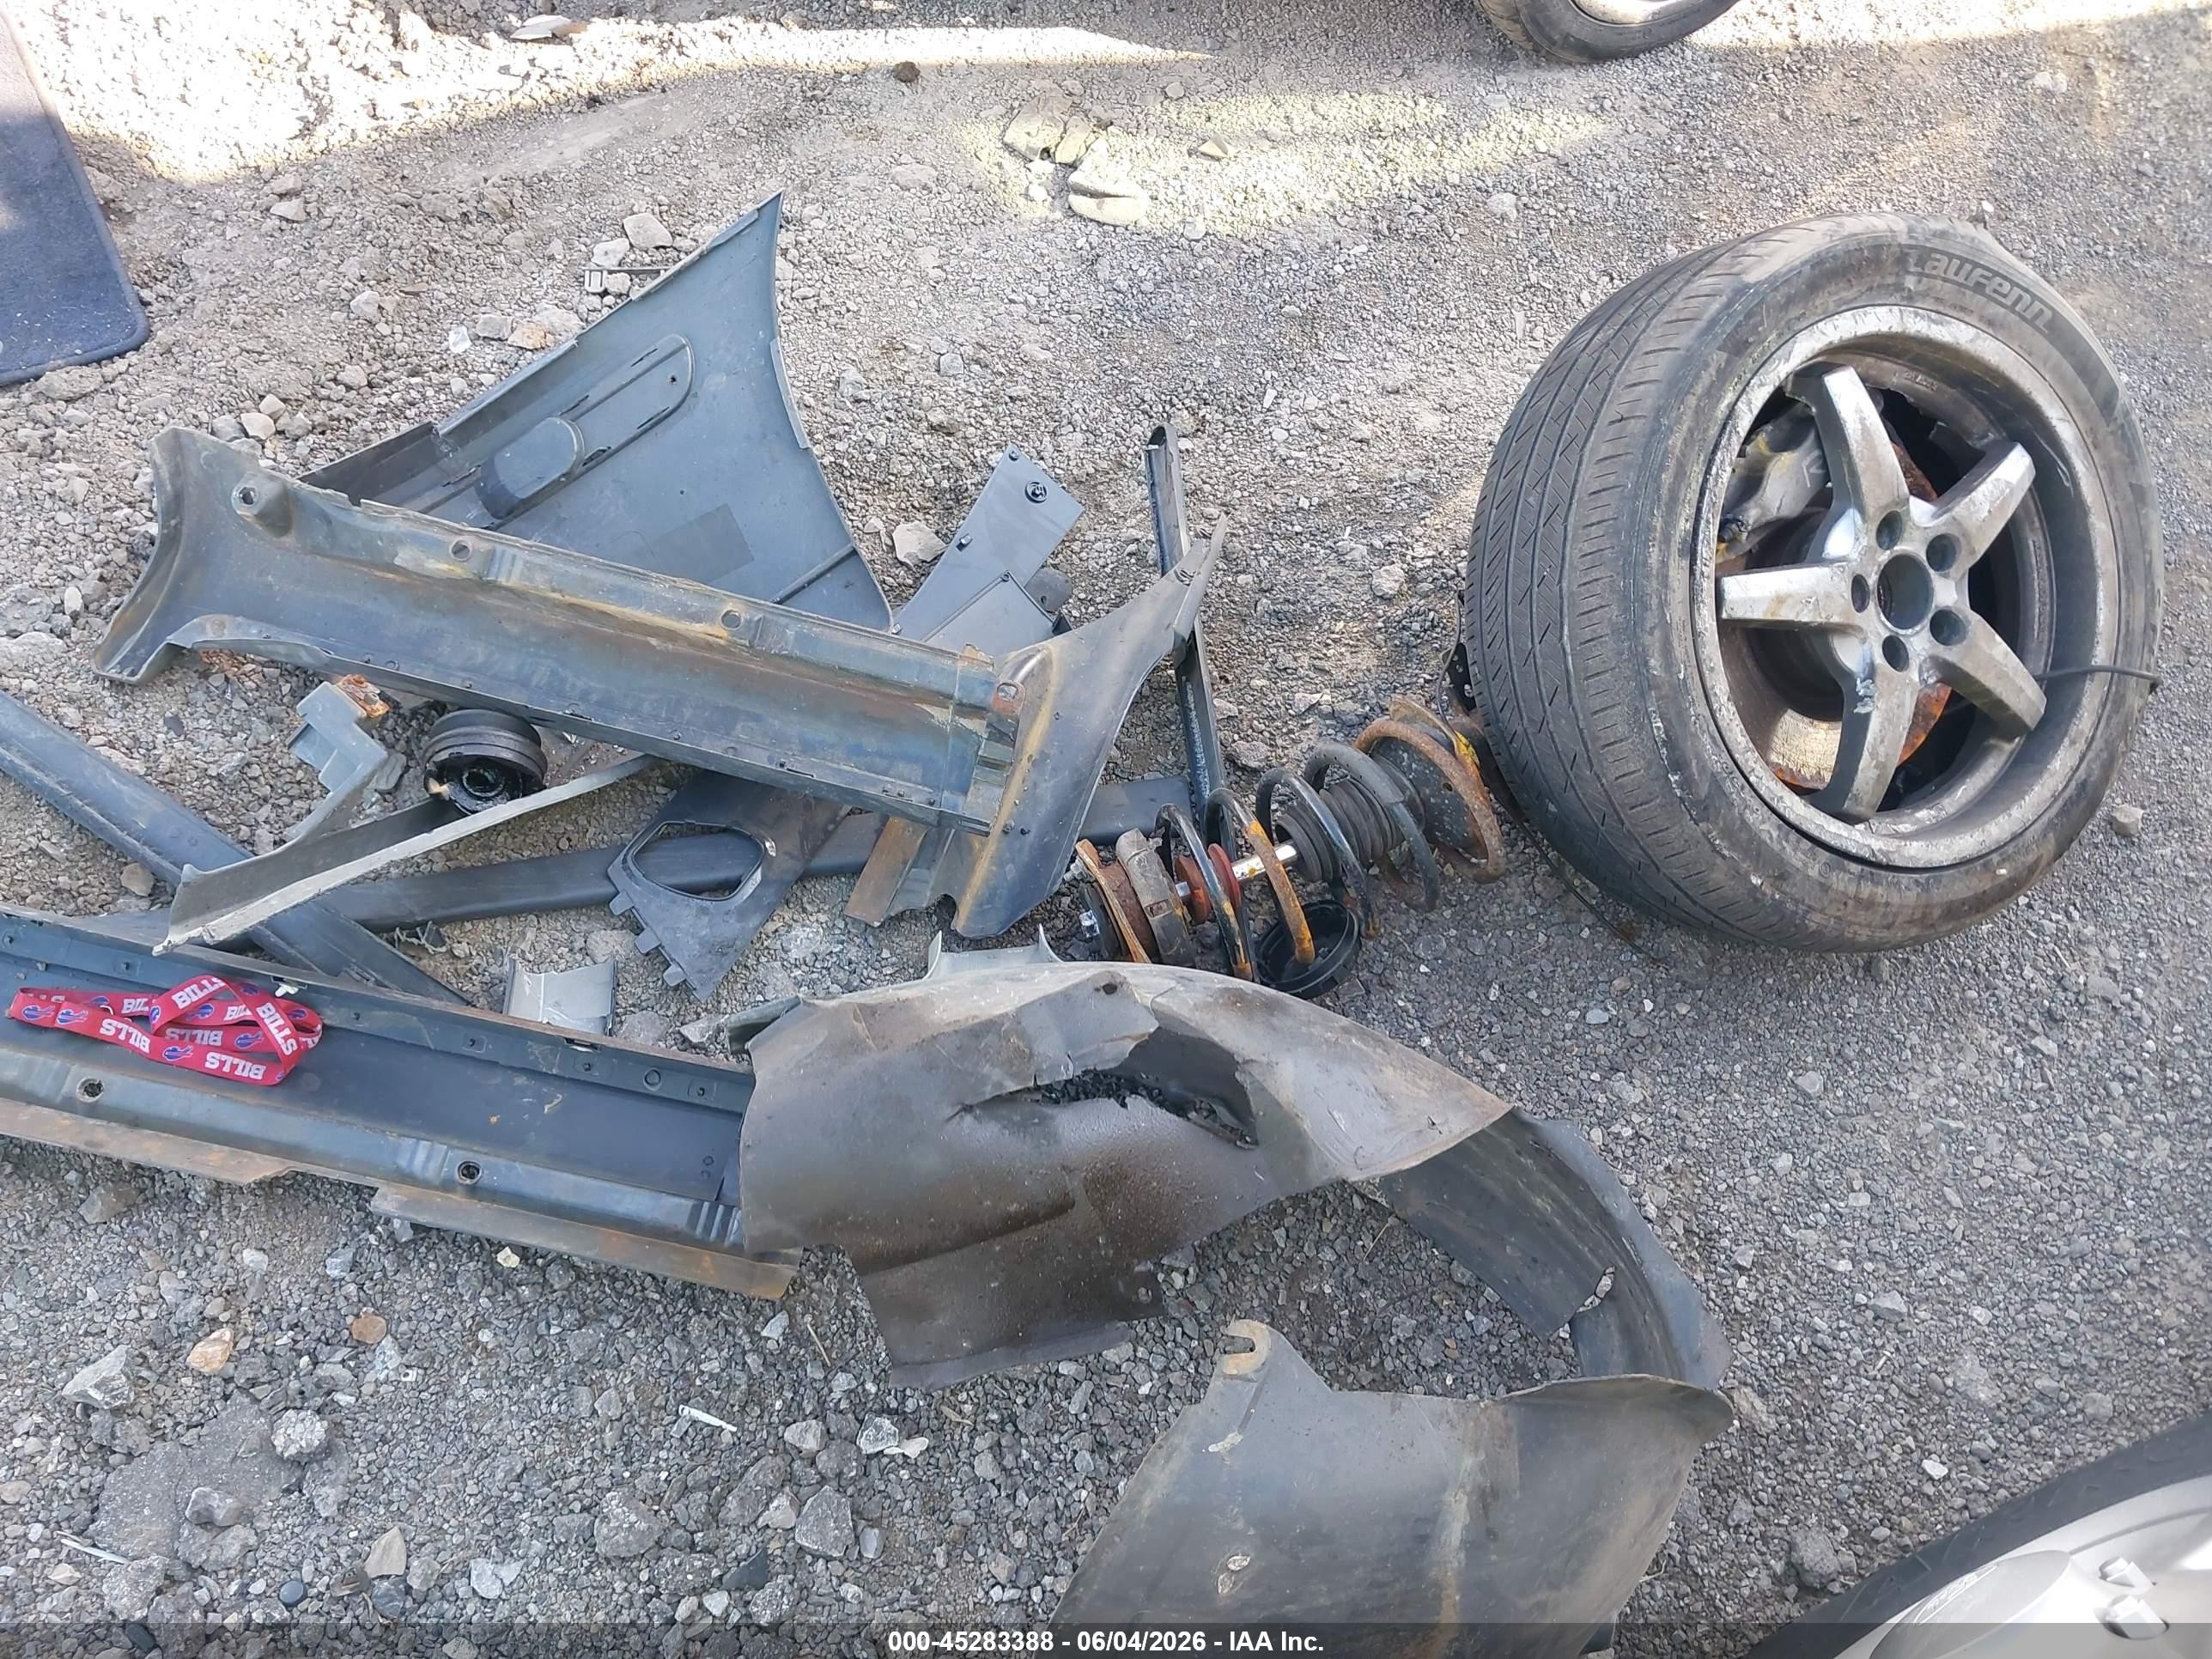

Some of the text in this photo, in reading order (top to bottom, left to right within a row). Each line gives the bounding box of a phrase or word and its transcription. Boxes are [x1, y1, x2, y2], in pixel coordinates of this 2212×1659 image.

[121, 998, 150, 1014] BIL
[171, 976, 226, 1010] BILLS
[223, 1004, 252, 1021] BIL
[100, 1018, 151, 1054] BILLS
[165, 1028, 223, 1047] BILLS
[256, 1002, 298, 1056] BILLS
[204, 1051, 267, 1080] BILLS
